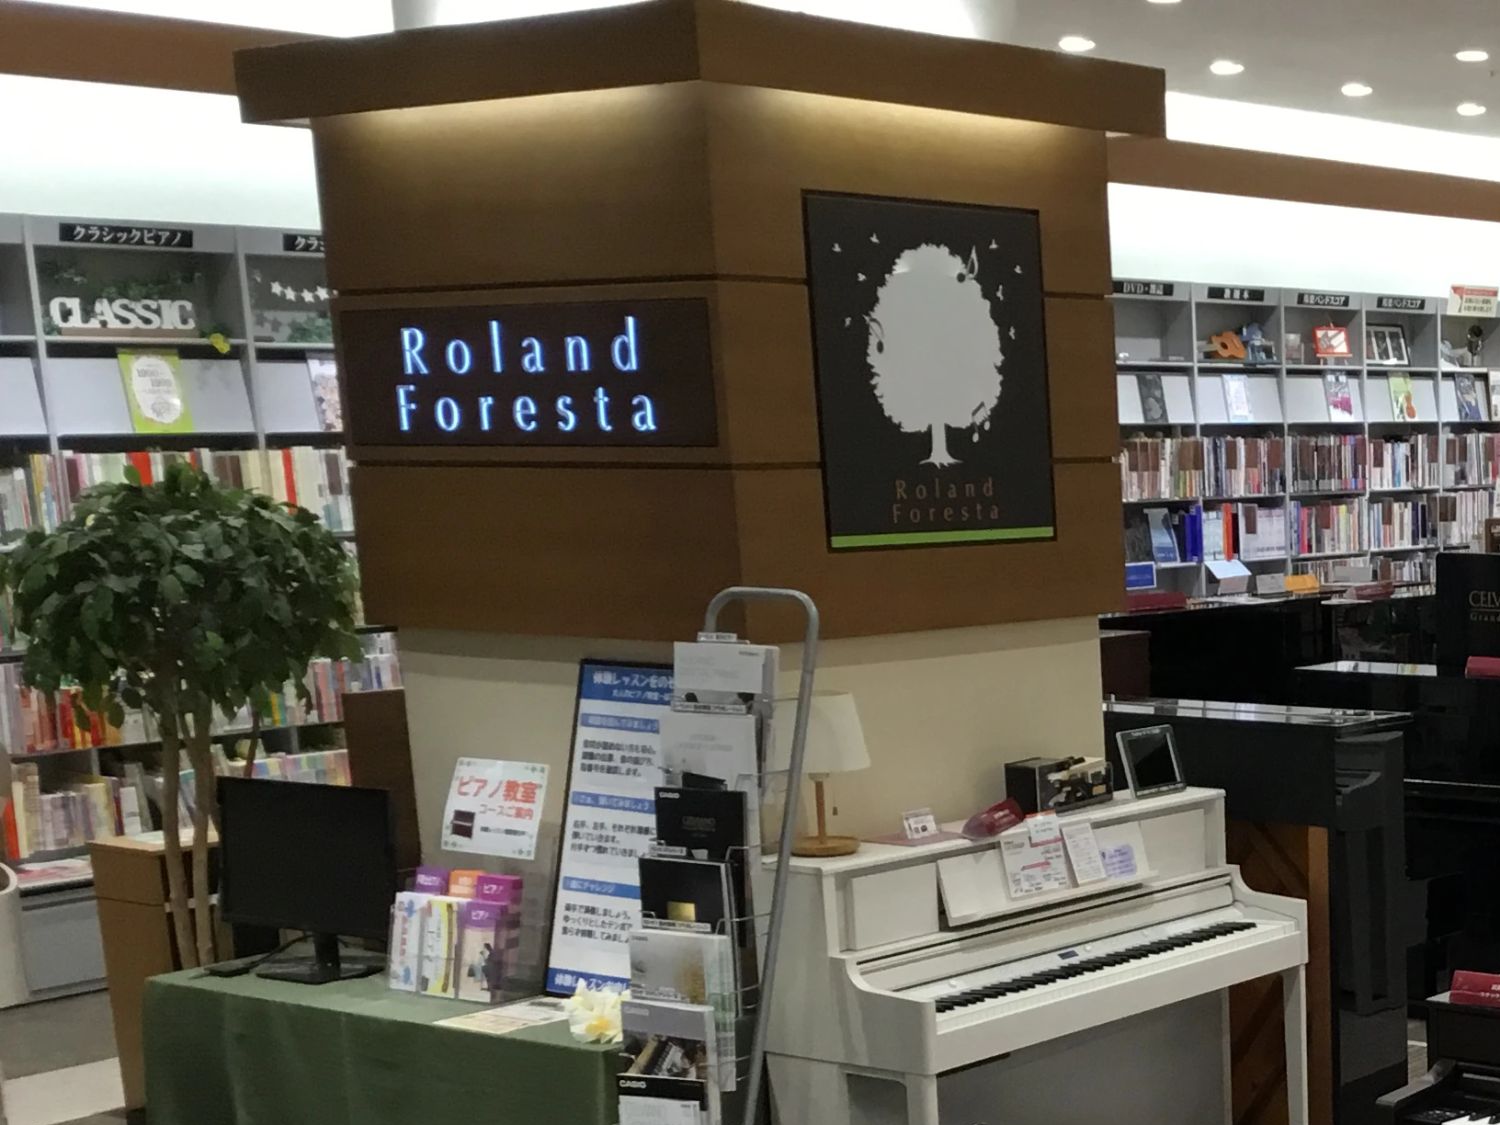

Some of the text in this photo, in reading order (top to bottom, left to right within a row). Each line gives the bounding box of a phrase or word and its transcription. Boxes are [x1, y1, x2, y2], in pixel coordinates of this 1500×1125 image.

[72, 224, 183, 246] クラシックピアノ
[49, 296, 196, 331] CLASSIC
[401, 315, 640, 377] Roland
[395, 384, 657, 433] Foresta
[895, 477, 994, 501] Roland
[892, 503, 1000, 524] Foresta
[618, 1078, 648, 1090] CASIO
